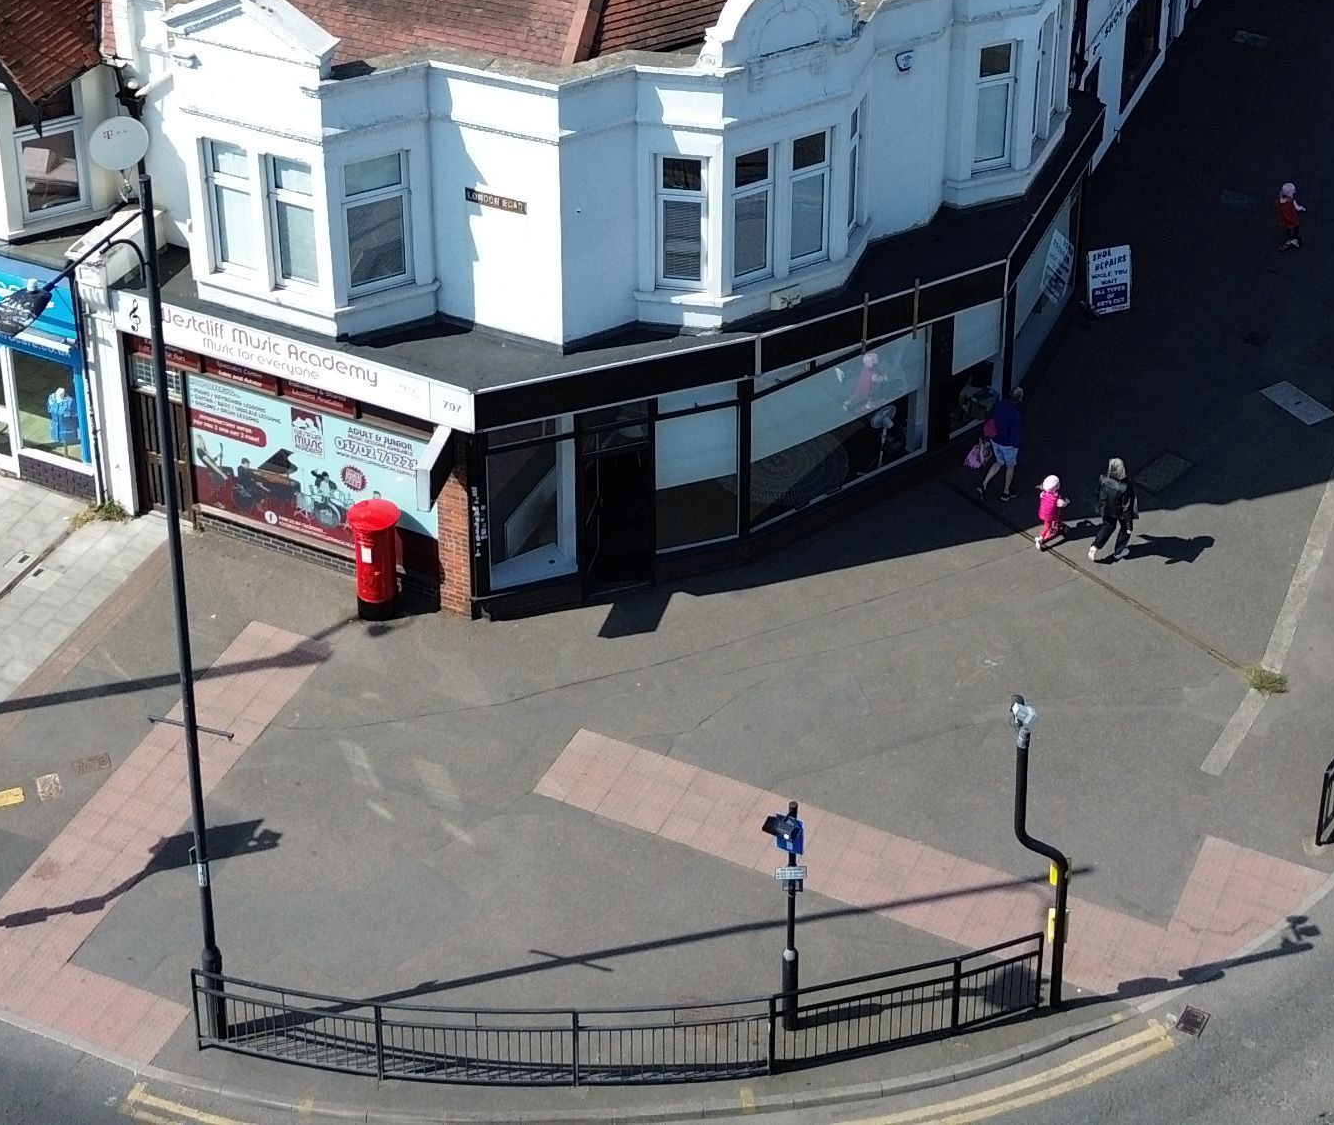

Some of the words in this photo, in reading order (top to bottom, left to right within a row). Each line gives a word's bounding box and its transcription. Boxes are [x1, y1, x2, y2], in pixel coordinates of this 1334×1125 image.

[466, 191, 500, 207] LONDON
[501, 198, 524, 213] ROAD
[1095, 255, 1127, 271] REPAIRS
[202, 337, 235, 355] Music
[237, 346, 254, 362] for
[256, 355, 320, 381] everyone
[231, 327, 281, 356] Music
[287, 343, 378, 387] Academy
[442, 400, 463, 413] 797
[347, 426, 373, 439] ADULT
[334, 436, 377, 460] 01702
